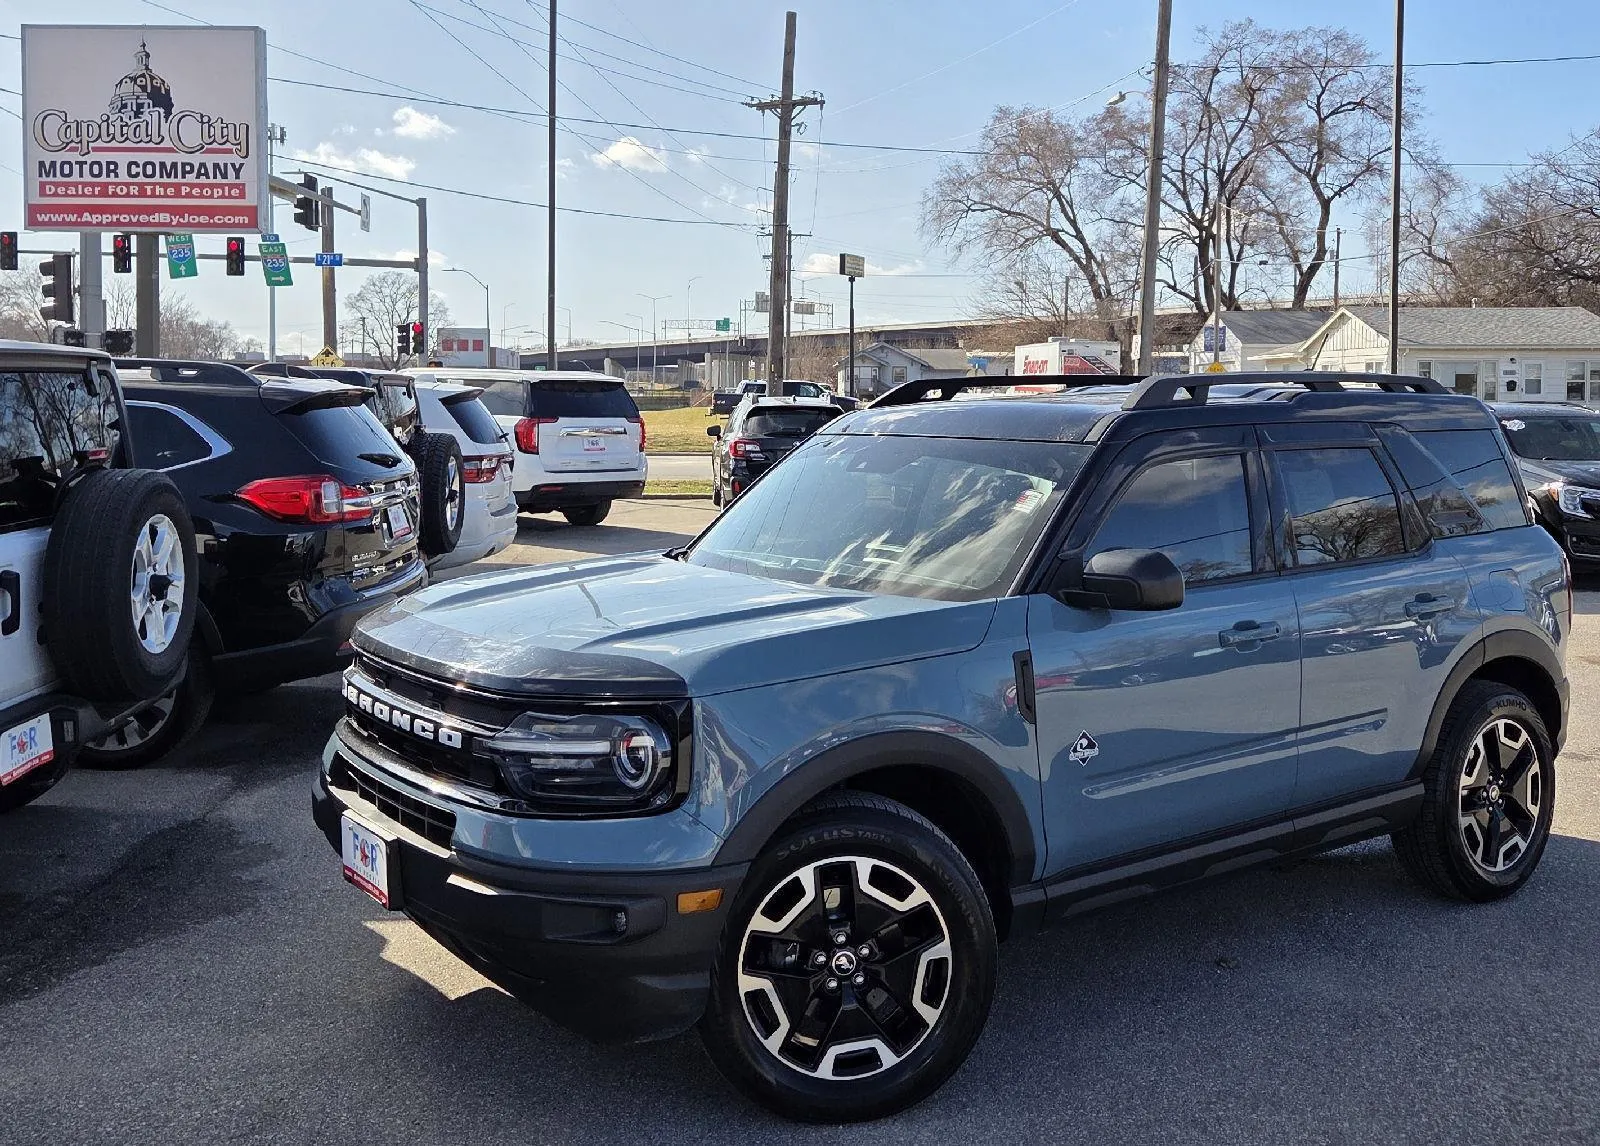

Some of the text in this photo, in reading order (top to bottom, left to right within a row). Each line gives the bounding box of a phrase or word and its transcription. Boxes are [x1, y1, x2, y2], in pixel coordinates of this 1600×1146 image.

[33, 109, 249, 158] Capital City
[38, 160, 245, 179] MOTOR COMPANY
[45, 184, 241, 198] Dealer FOR The People
[36, 212, 249, 225] www.ApprovedByJoe.com
[167, 234, 190, 242] WEST
[171, 249, 191, 259] 235
[262, 245, 283, 253] EAST
[266, 258, 285, 269] 235
[1496, 699, 1527, 711] KUMHO
[347, 685, 463, 749] BRONCO
